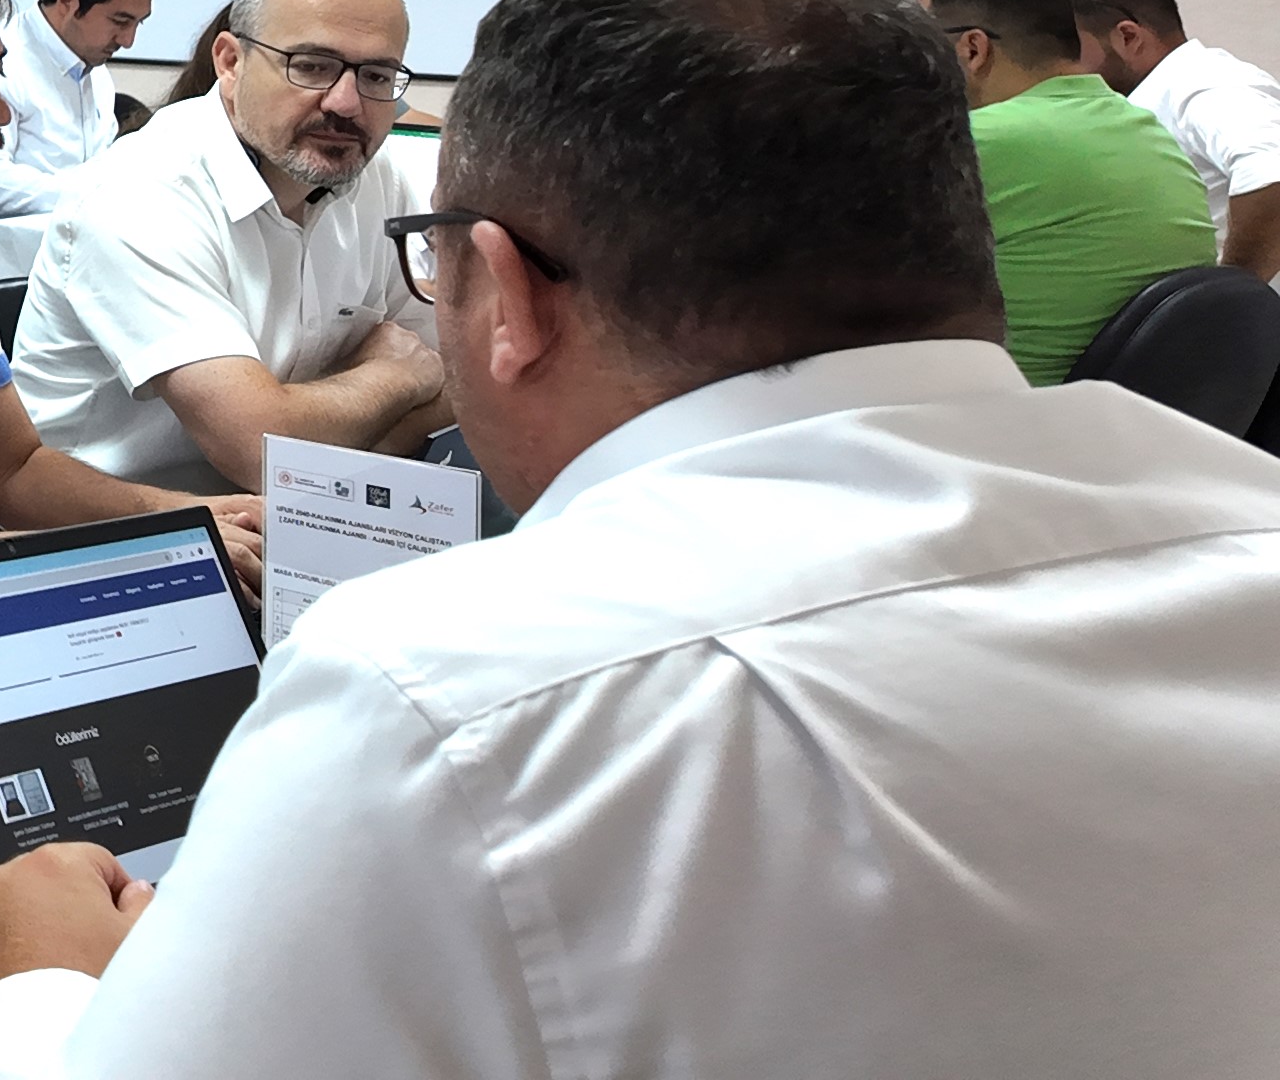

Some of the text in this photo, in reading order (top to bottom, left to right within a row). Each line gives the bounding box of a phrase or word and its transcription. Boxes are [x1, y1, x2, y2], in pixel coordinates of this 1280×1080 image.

[427, 501, 454, 513] Zafer
[348, 520, 387, 534] AJANSLARI
[273, 568, 293, 577] MASA
